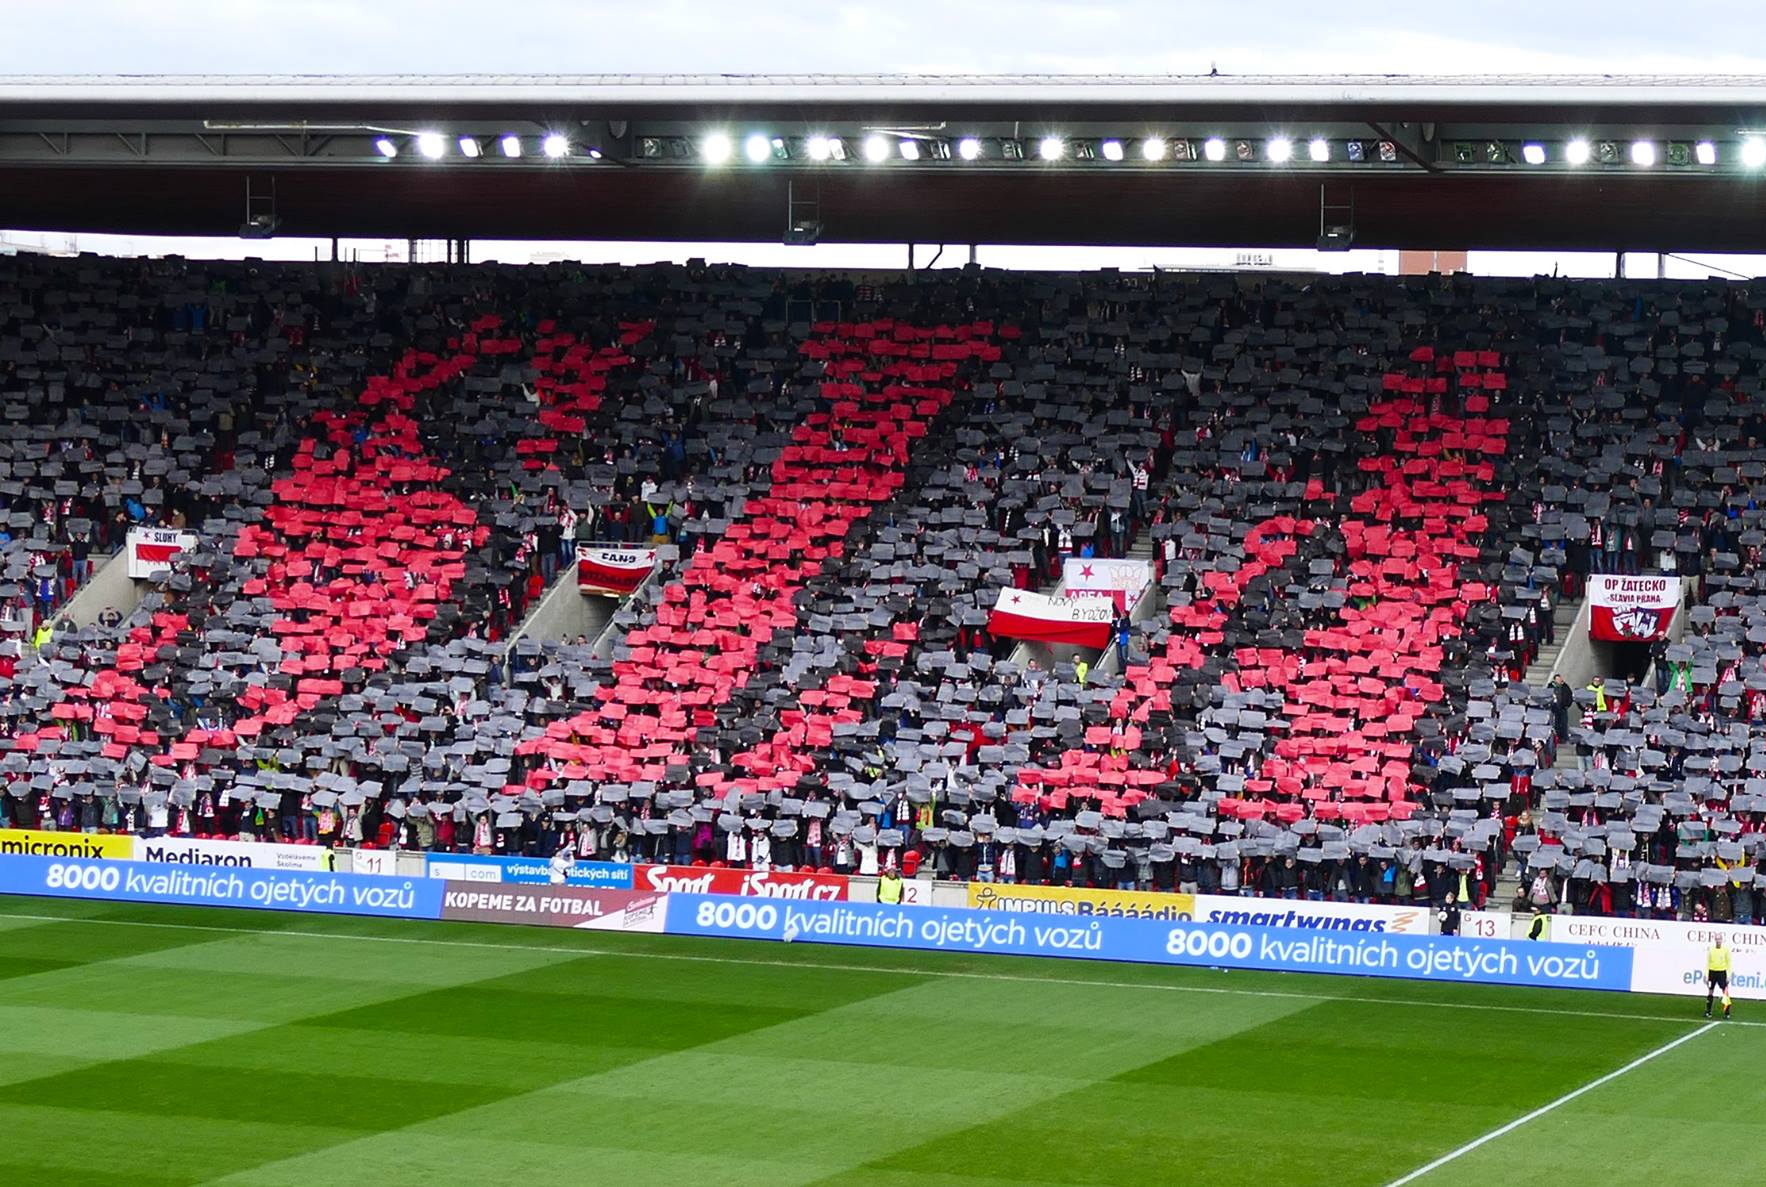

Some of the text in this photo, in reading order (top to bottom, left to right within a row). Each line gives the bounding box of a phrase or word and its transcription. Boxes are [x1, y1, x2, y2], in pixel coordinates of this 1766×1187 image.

[1604, 577, 1666, 591] OP ŽATECKO
[1, 835, 104, 858] micronix
[146, 847, 252, 867] Mediaron
[367, 858, 382, 873] 11
[507, 864, 551, 879] výstavb
[566, 866, 609, 882] tických
[46, 864, 414, 908] 8000 kvalitních ojetých vozů
[741, 872, 841, 901] iSportcz
[445, 892, 603, 915] KOPEME ZA FOTBAL
[998, 898, 1075, 916] IMPULS
[696, 903, 1102, 949] 8000 kvalitních ojetých vozů
[1206, 909, 1387, 932] smartwings
[1464, 914, 1471, 922] G
[1475, 920, 1495, 936] 13
[1569, 923, 1661, 940] CEFC CHINA
[1167, 928, 1599, 979] 8000 kvalitních ojetých vozů
